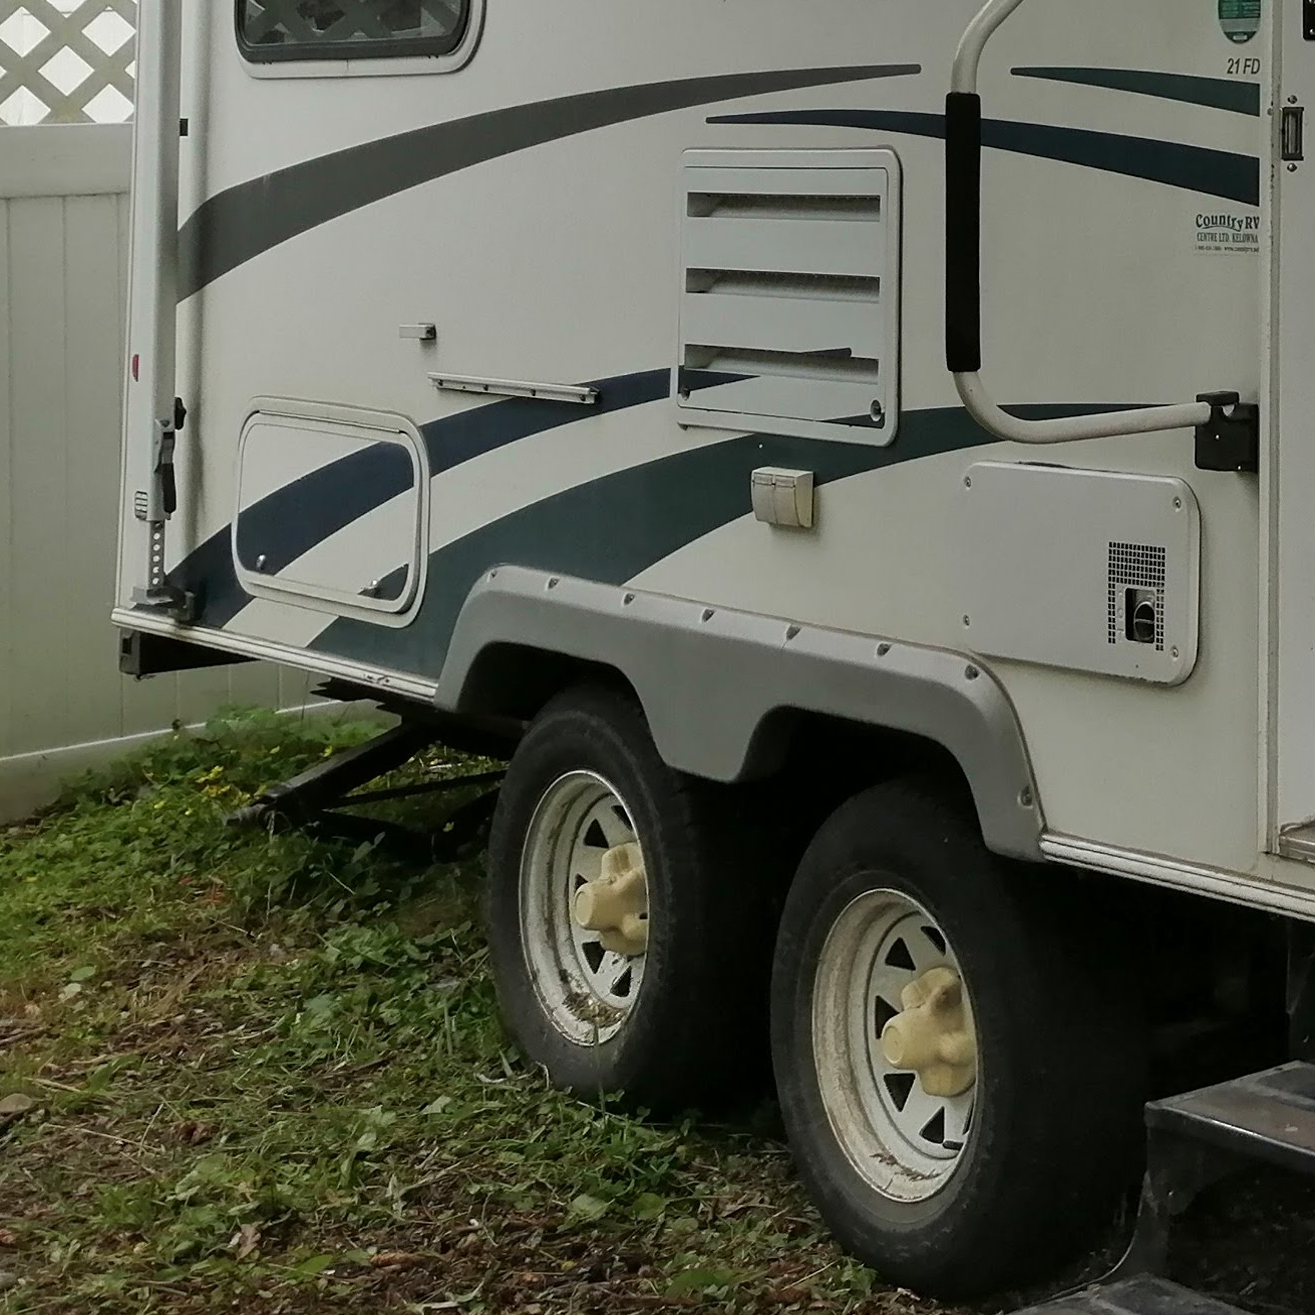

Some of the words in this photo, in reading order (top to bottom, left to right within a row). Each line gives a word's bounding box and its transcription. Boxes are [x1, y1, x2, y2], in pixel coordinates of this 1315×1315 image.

[1226, 57, 1241, 75] 21
[1243, 57, 1261, 75] FD
[1195, 213, 1244, 232] Country
[1245, 216, 1260, 229] RV
